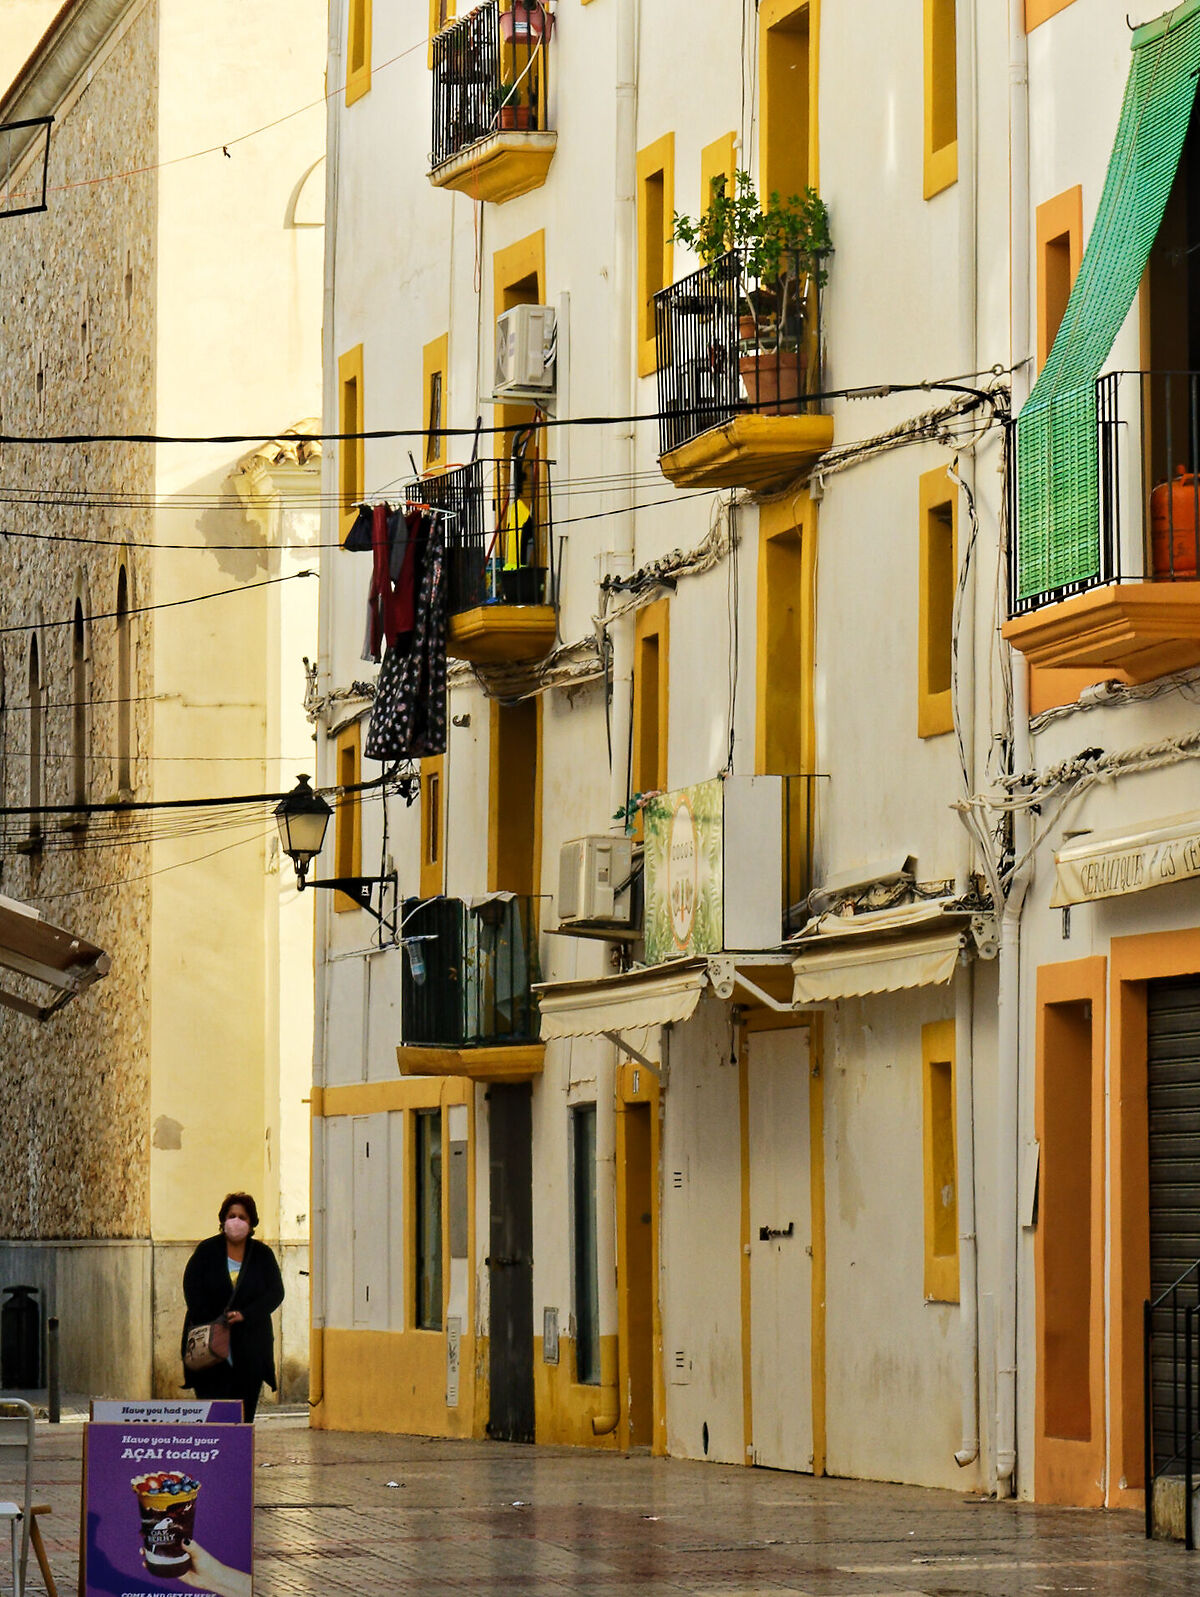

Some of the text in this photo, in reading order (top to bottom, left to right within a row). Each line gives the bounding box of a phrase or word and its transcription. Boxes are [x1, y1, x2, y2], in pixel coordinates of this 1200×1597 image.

[146, 1408, 162, 1416] you
[182, 1408, 203, 1416] your
[121, 1435, 220, 1446] Have you had your
[120, 1448, 220, 1463] AÇAI today?
